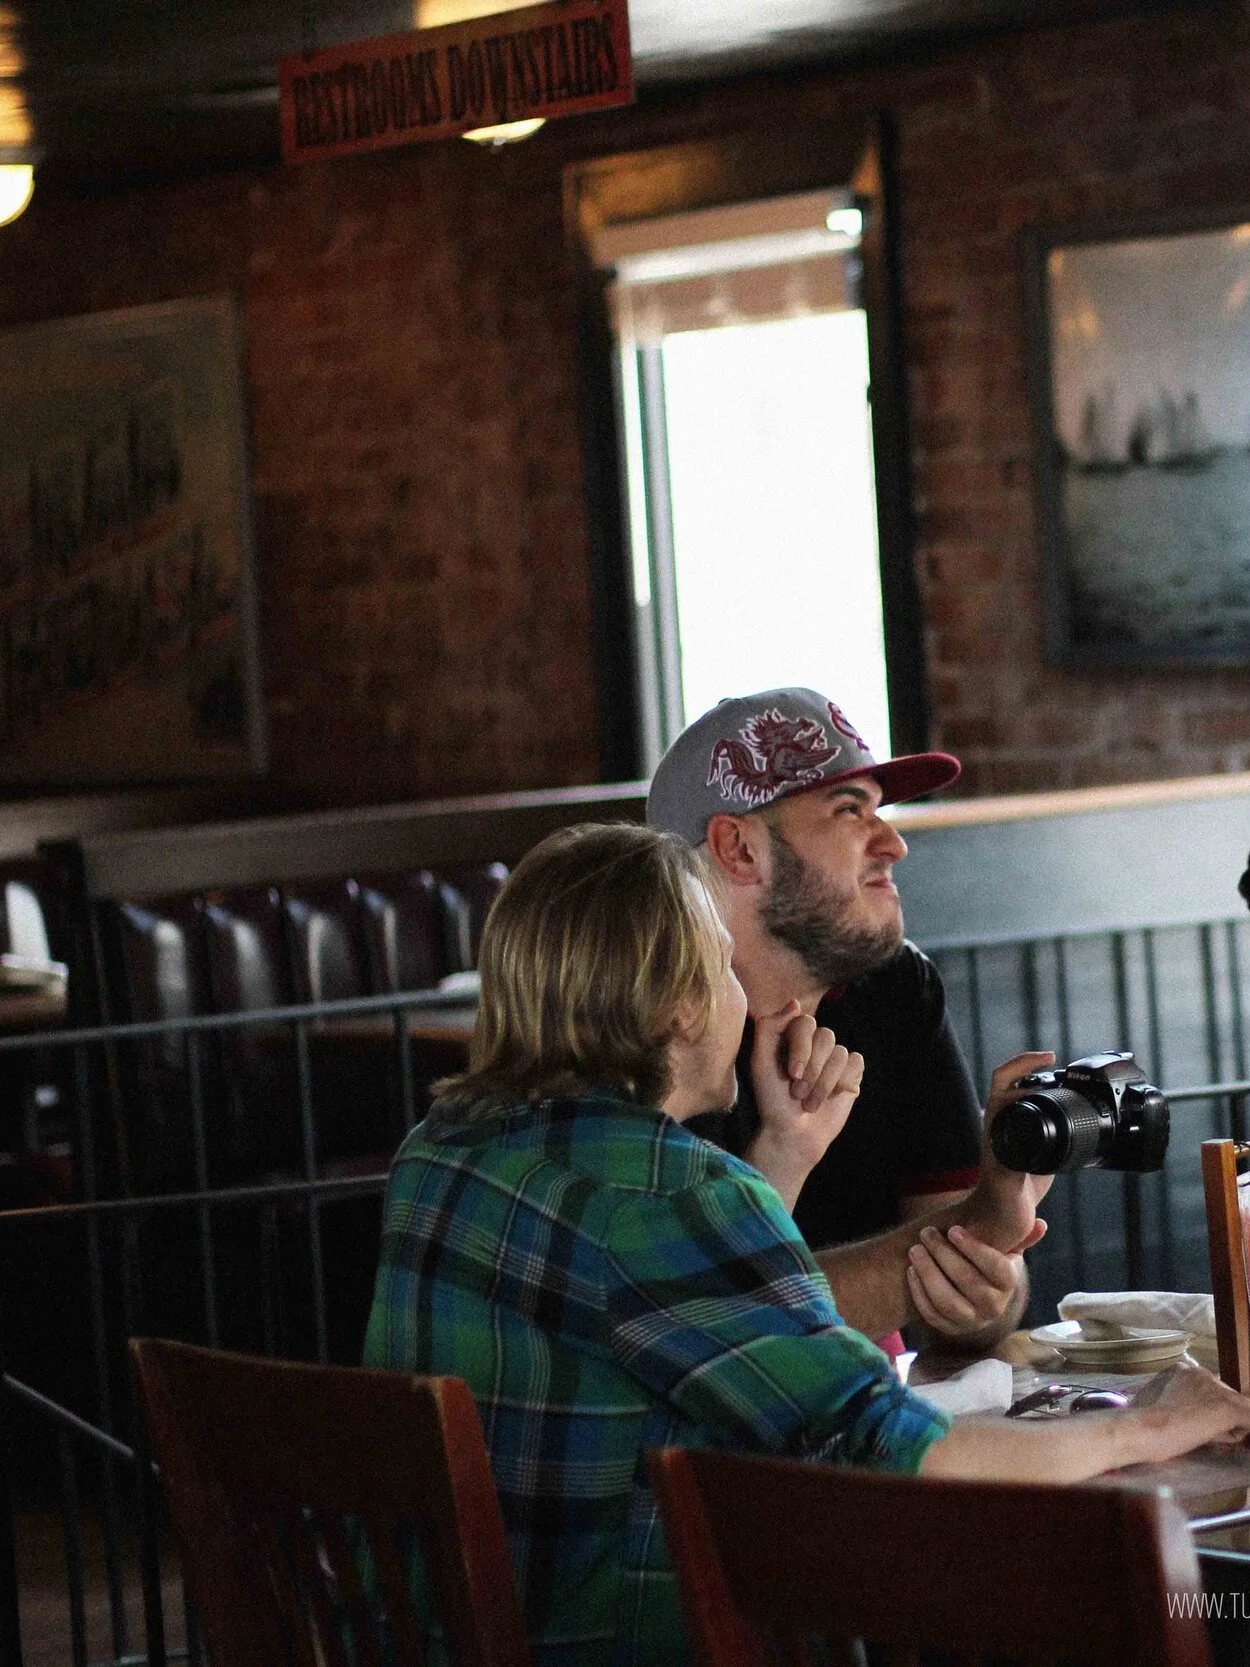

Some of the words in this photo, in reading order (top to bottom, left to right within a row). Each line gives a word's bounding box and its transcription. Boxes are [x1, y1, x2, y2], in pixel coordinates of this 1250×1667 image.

[293, 50, 443, 146] RESTROOMS
[448, 12, 619, 122] DOWNSTAIRS
[1067, 1071, 1091, 1081] Nikon
